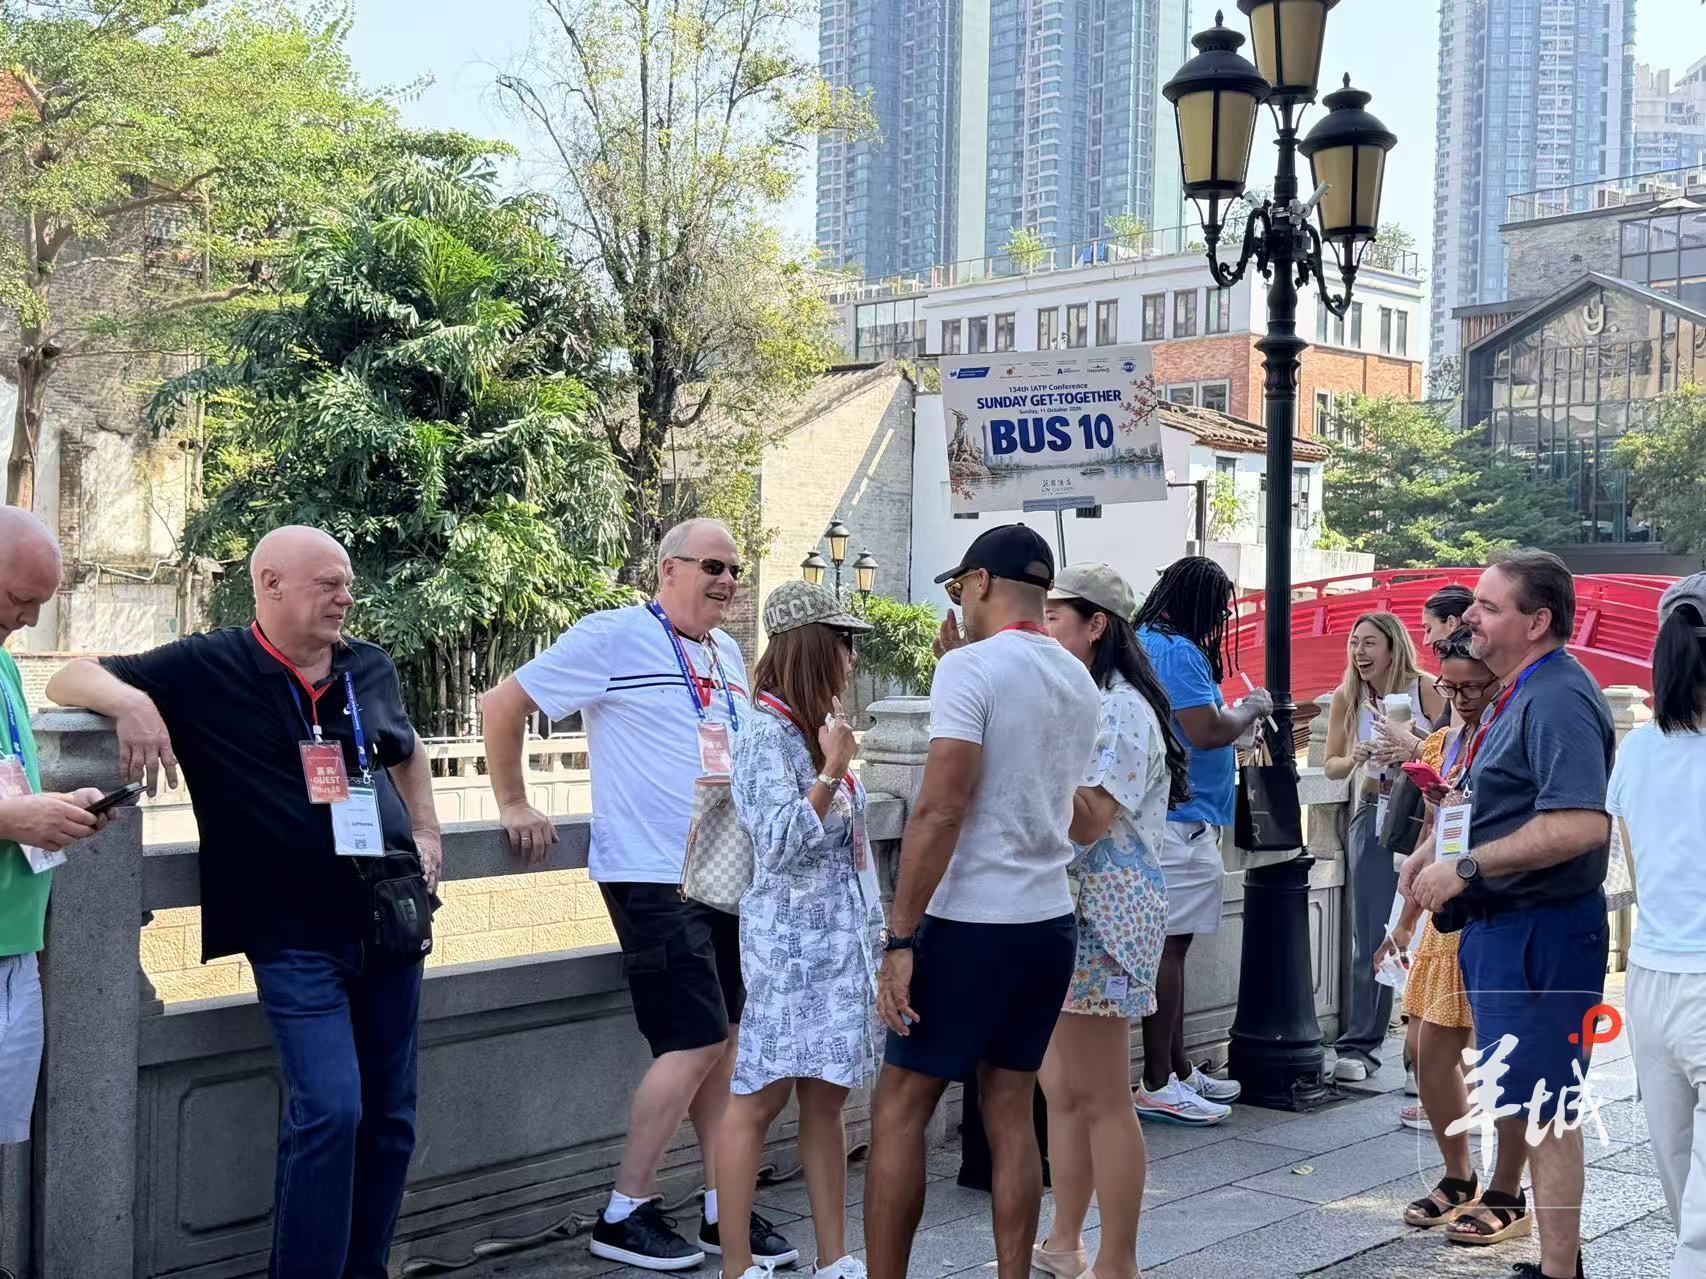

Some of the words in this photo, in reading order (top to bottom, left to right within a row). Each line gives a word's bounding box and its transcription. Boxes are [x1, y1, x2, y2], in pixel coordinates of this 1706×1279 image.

[1009, 385, 1029, 393] 134th
[1049, 383, 1088, 391] Conference
[977, 394, 1028, 410] SUNDAY
[1030, 389, 1122, 407] GET-TOGETHER
[990, 414, 1072, 455] BUS
[1079, 413, 1114, 450] 10
[313, 775, 340, 784] GUEST
